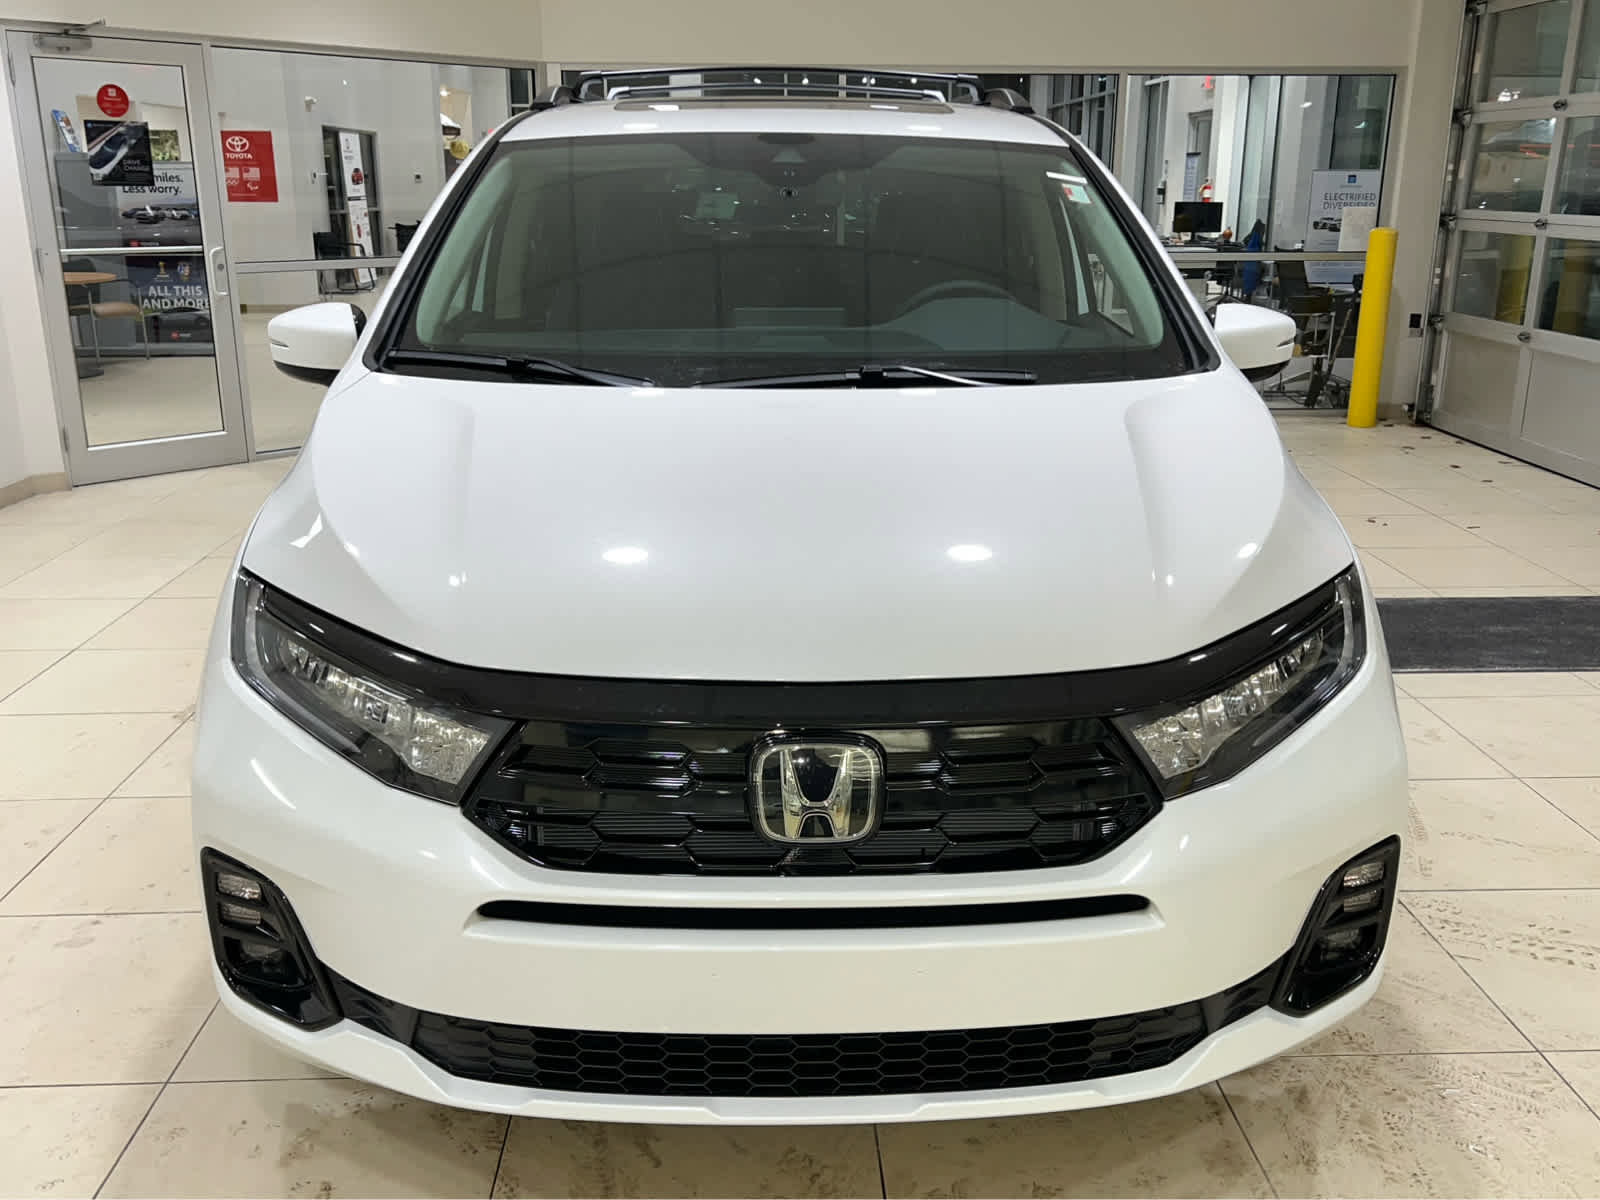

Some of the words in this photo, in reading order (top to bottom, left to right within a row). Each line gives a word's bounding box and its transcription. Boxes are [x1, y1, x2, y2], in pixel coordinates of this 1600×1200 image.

[225, 152, 253, 160] TOYOTA
[122, 185, 147, 194] Less
[148, 185, 183, 196] worry.
[1323, 192, 1377, 201] ELECTRIFIED
[148, 286, 172, 297] ALL
[173, 286, 203, 297] THIS
[142, 298, 171, 310] AND
